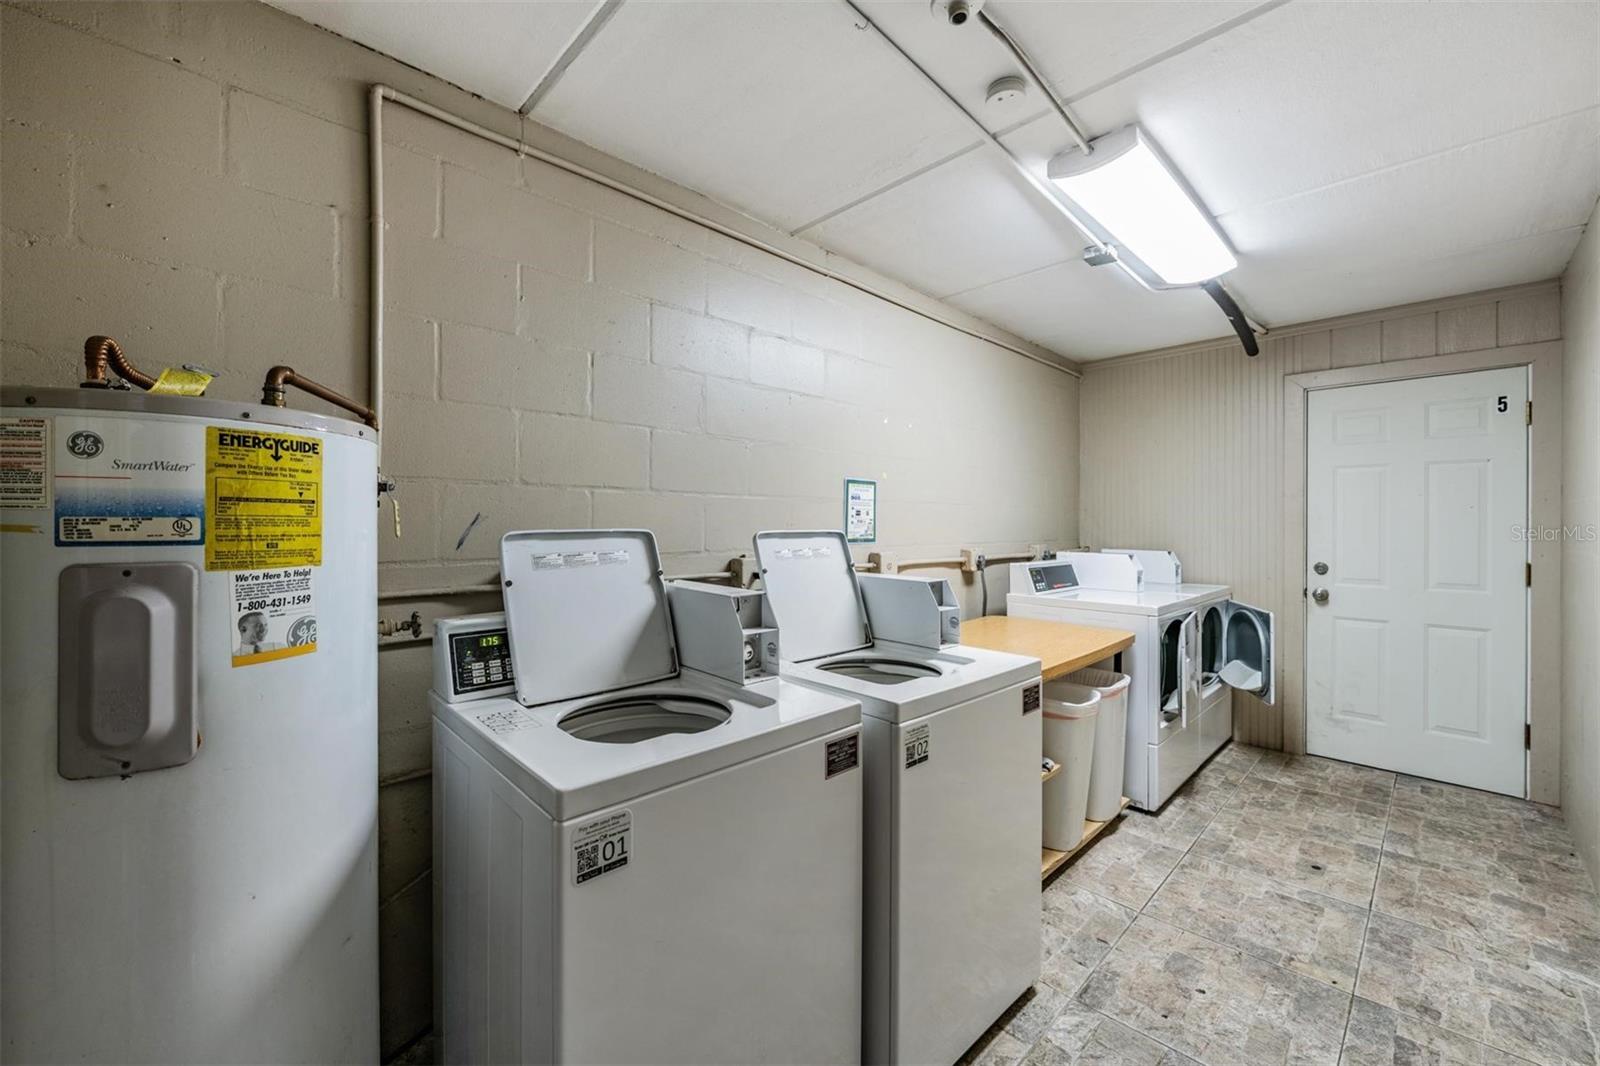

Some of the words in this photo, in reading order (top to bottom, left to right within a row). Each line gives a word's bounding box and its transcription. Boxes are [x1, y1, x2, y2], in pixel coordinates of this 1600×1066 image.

[1497, 396, 1508, 413] 5
[218, 432, 319, 456] ENERGYGUIDE
[235, 573, 260, 583] We're
[262, 572, 281, 581] Here
[284, 570, 292, 578] To
[293, 568, 312, 578] Help!
[237, 594, 312, 612] 1-800-431-1549
[916, 740, 929, 757] 02
[602, 836, 628, 861] 01
